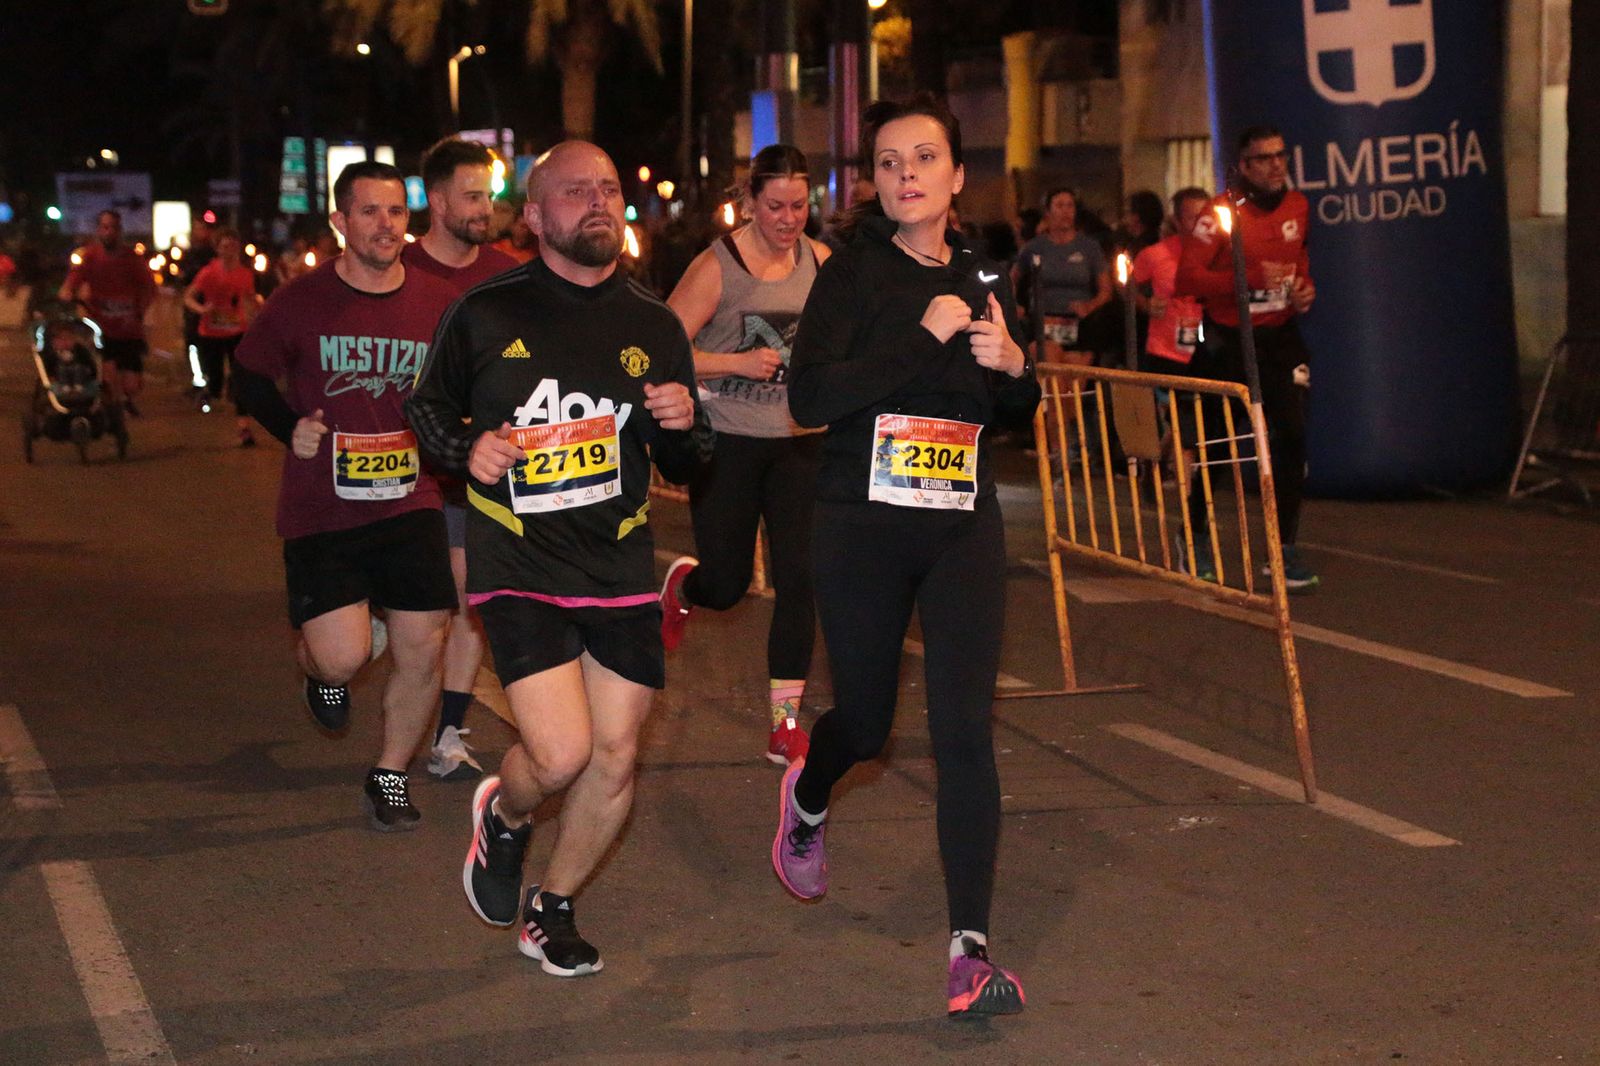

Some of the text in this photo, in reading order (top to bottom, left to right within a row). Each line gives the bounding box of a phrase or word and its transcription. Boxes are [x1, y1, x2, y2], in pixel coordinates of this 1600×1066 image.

[1317, 186, 1447, 224] CIUDAD
[502, 351, 531, 359] adidas
[356, 452, 411, 473] 2204
[534, 443, 607, 476] 2719
[904, 445, 966, 472] 2304
